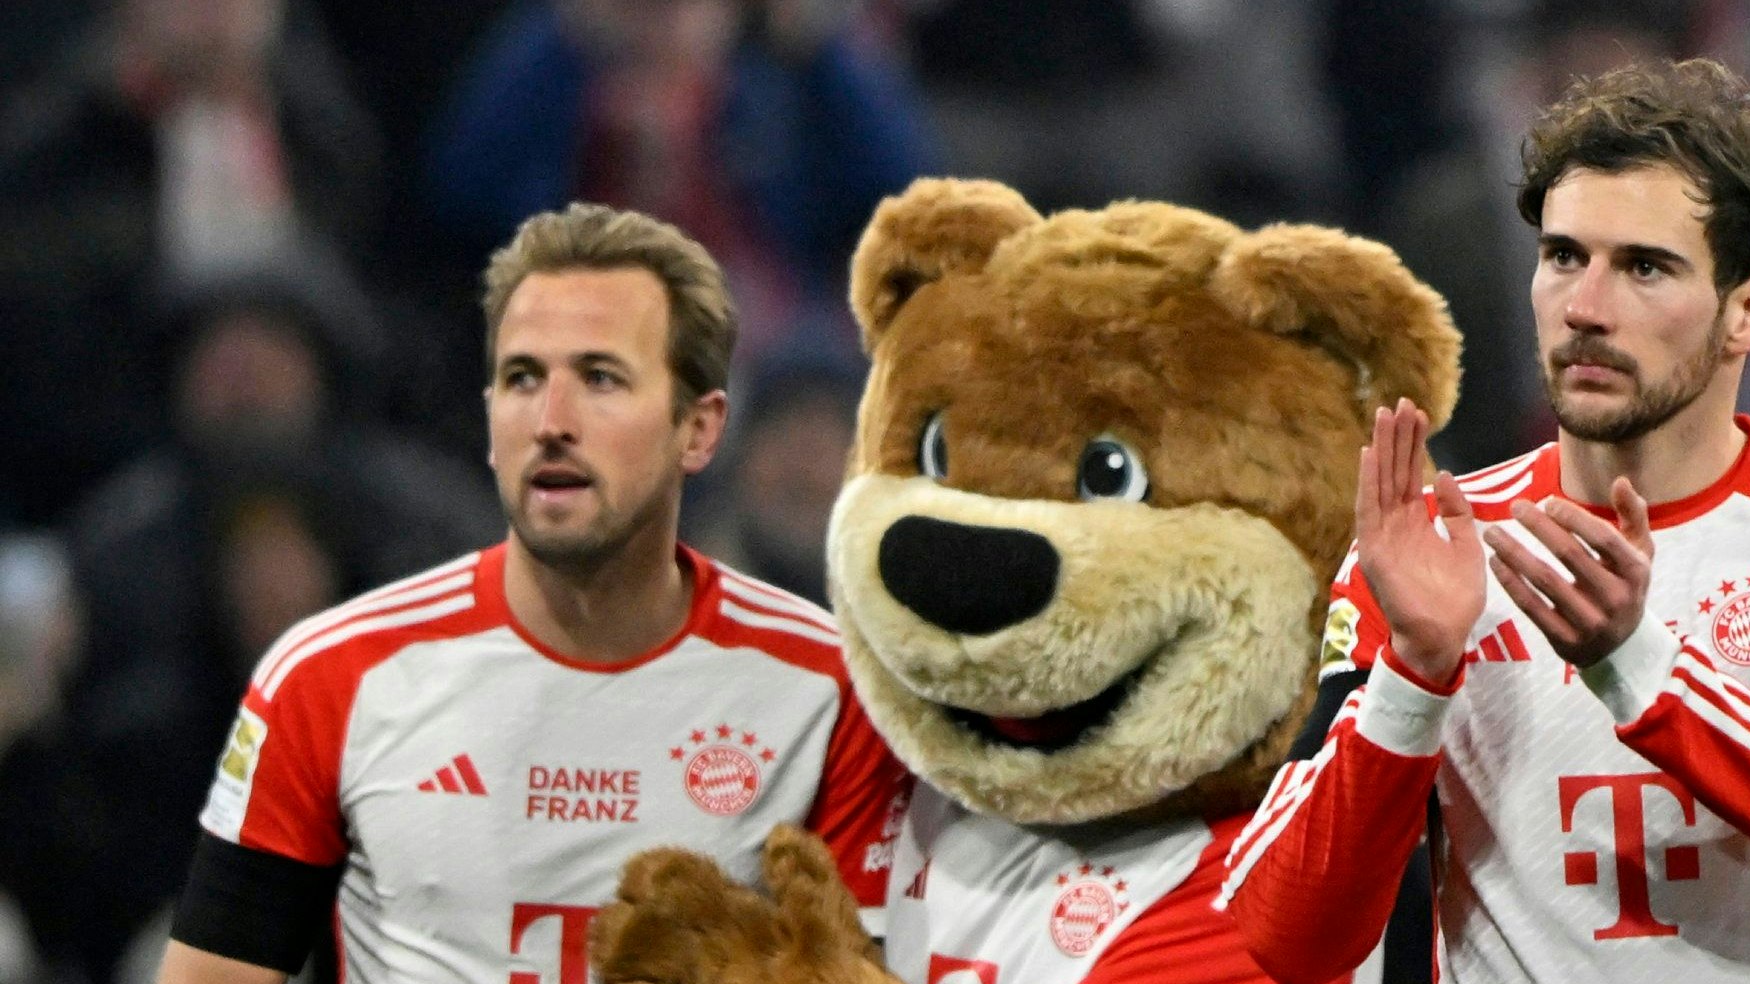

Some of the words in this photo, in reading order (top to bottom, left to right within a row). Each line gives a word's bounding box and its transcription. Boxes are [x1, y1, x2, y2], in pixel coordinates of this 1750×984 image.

[529, 765, 641, 794] DANKE
[527, 795, 639, 822] FRANZ
[1558, 771, 1700, 941] T
